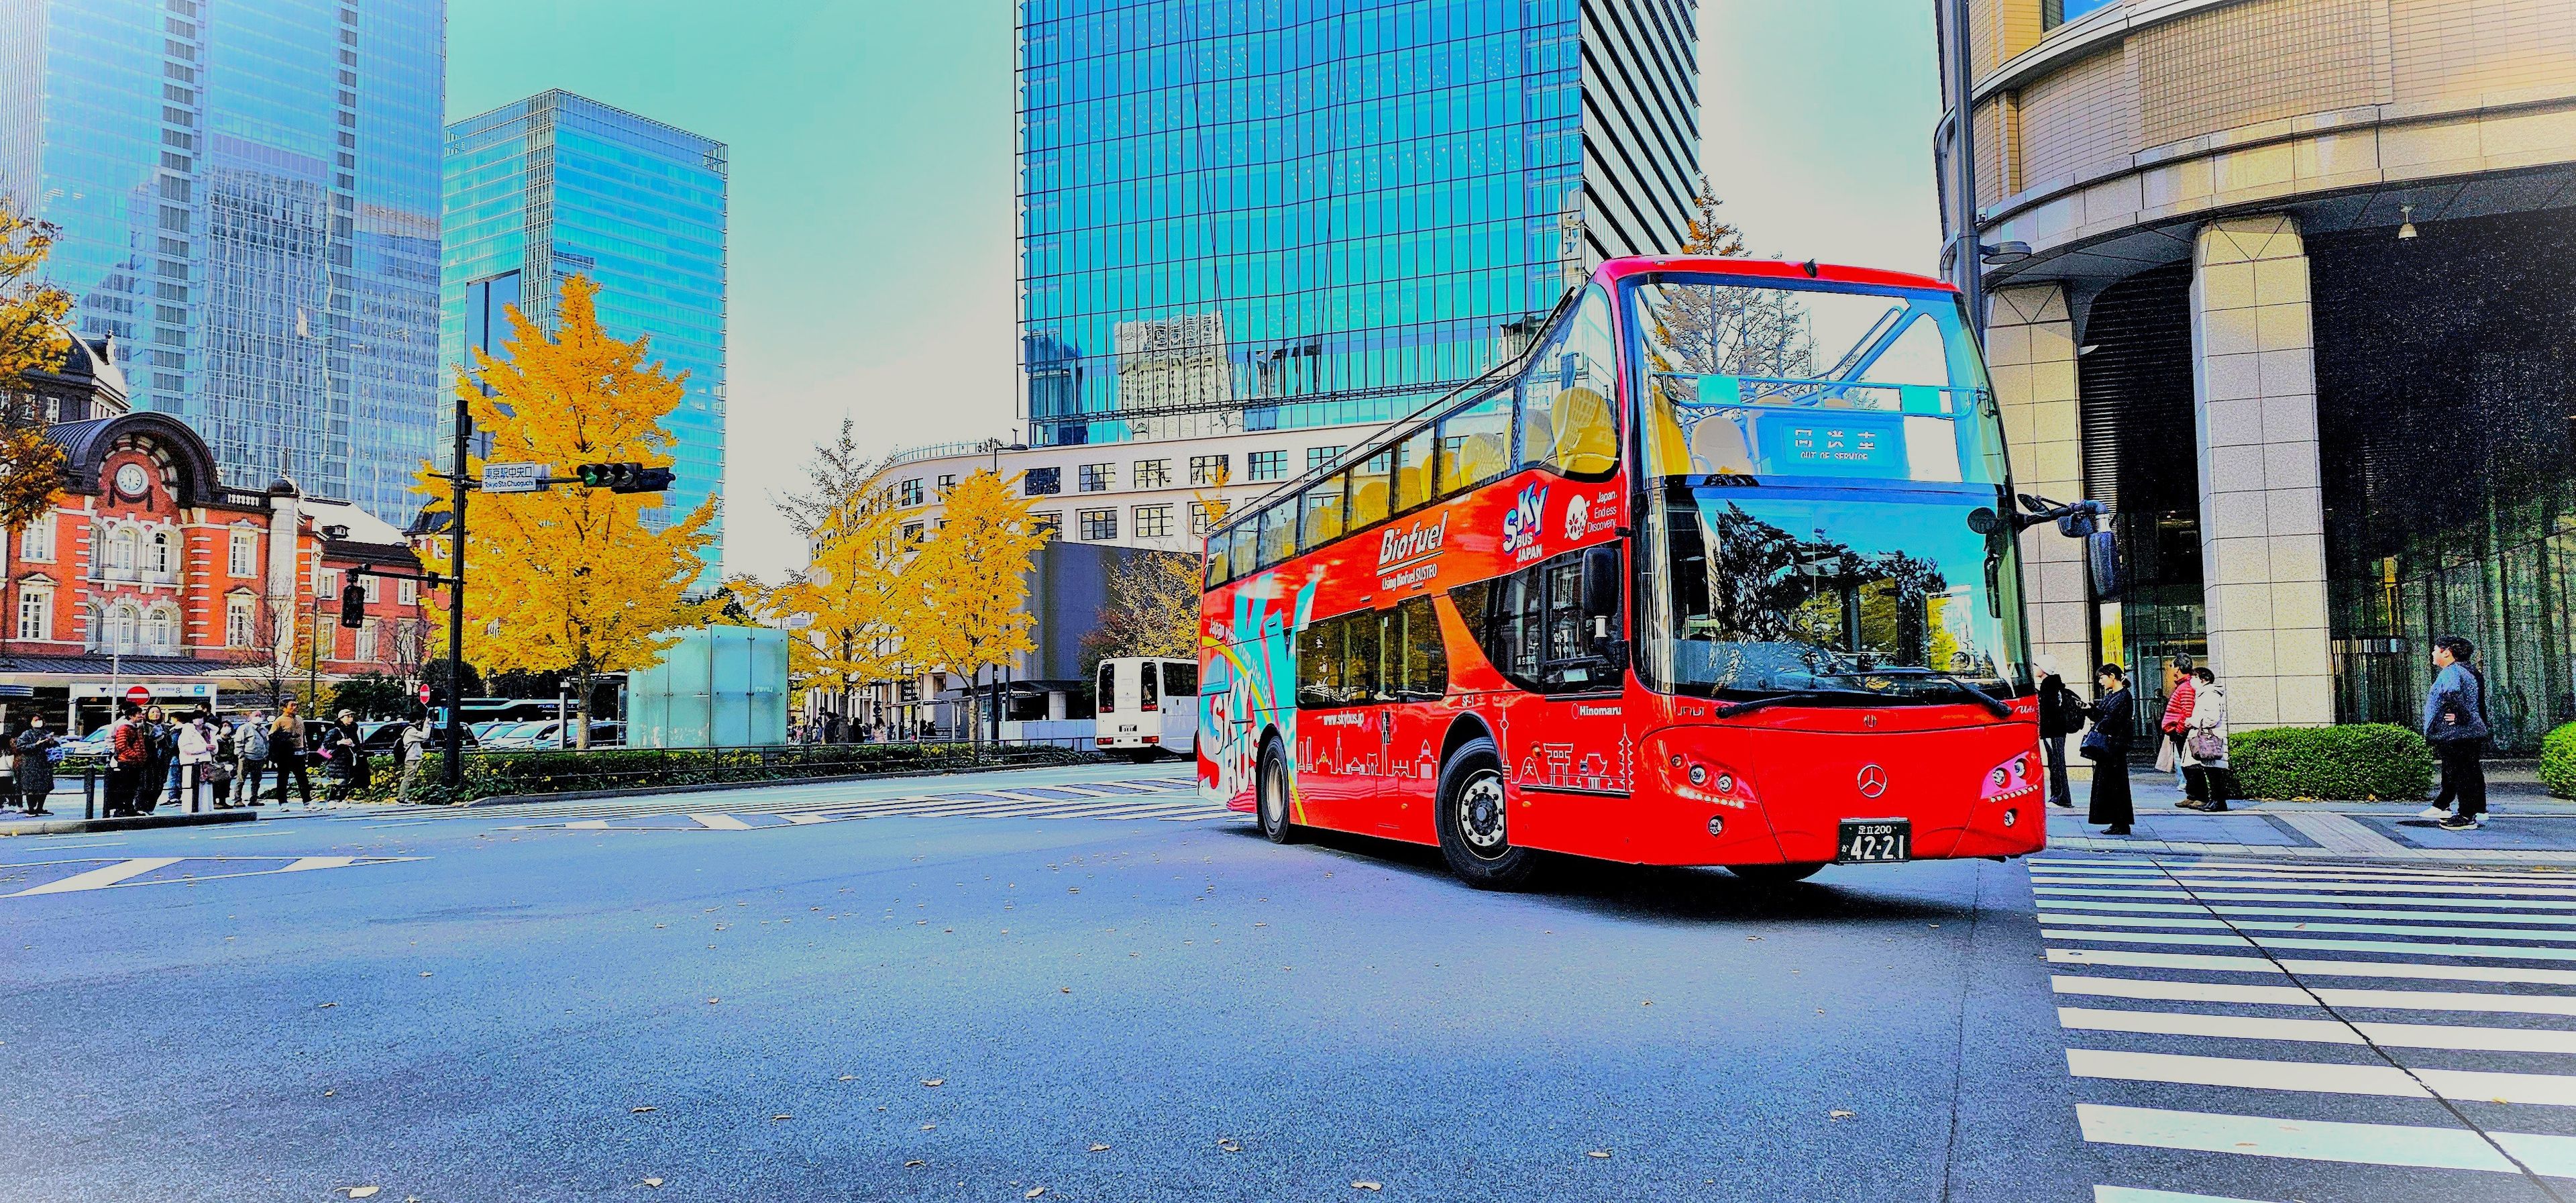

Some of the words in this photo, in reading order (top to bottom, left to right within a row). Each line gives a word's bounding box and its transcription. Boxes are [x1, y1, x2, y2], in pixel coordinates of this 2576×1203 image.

[485, 467, 532, 480] 東京駅中央口
[1502, 481, 1550, 554] SKY
[1594, 505, 1617, 519] Endless
[1379, 510, 1449, 566] Biofuel
[1516, 532, 1534, 549] BUS
[1516, 543, 1542, 563] JAPAN
[1383, 576, 1397, 591] Using
[1209, 617, 1226, 641] Japan
[1251, 658, 1262, 685] the
[1212, 669, 1253, 755] SKY
[1324, 709, 1364, 728] www.skybus.jp
[1579, 705, 1622, 716] Hinomaru
[1524, 762, 1535, 776] 大
[1850, 835, 1904, 860] 42-21
